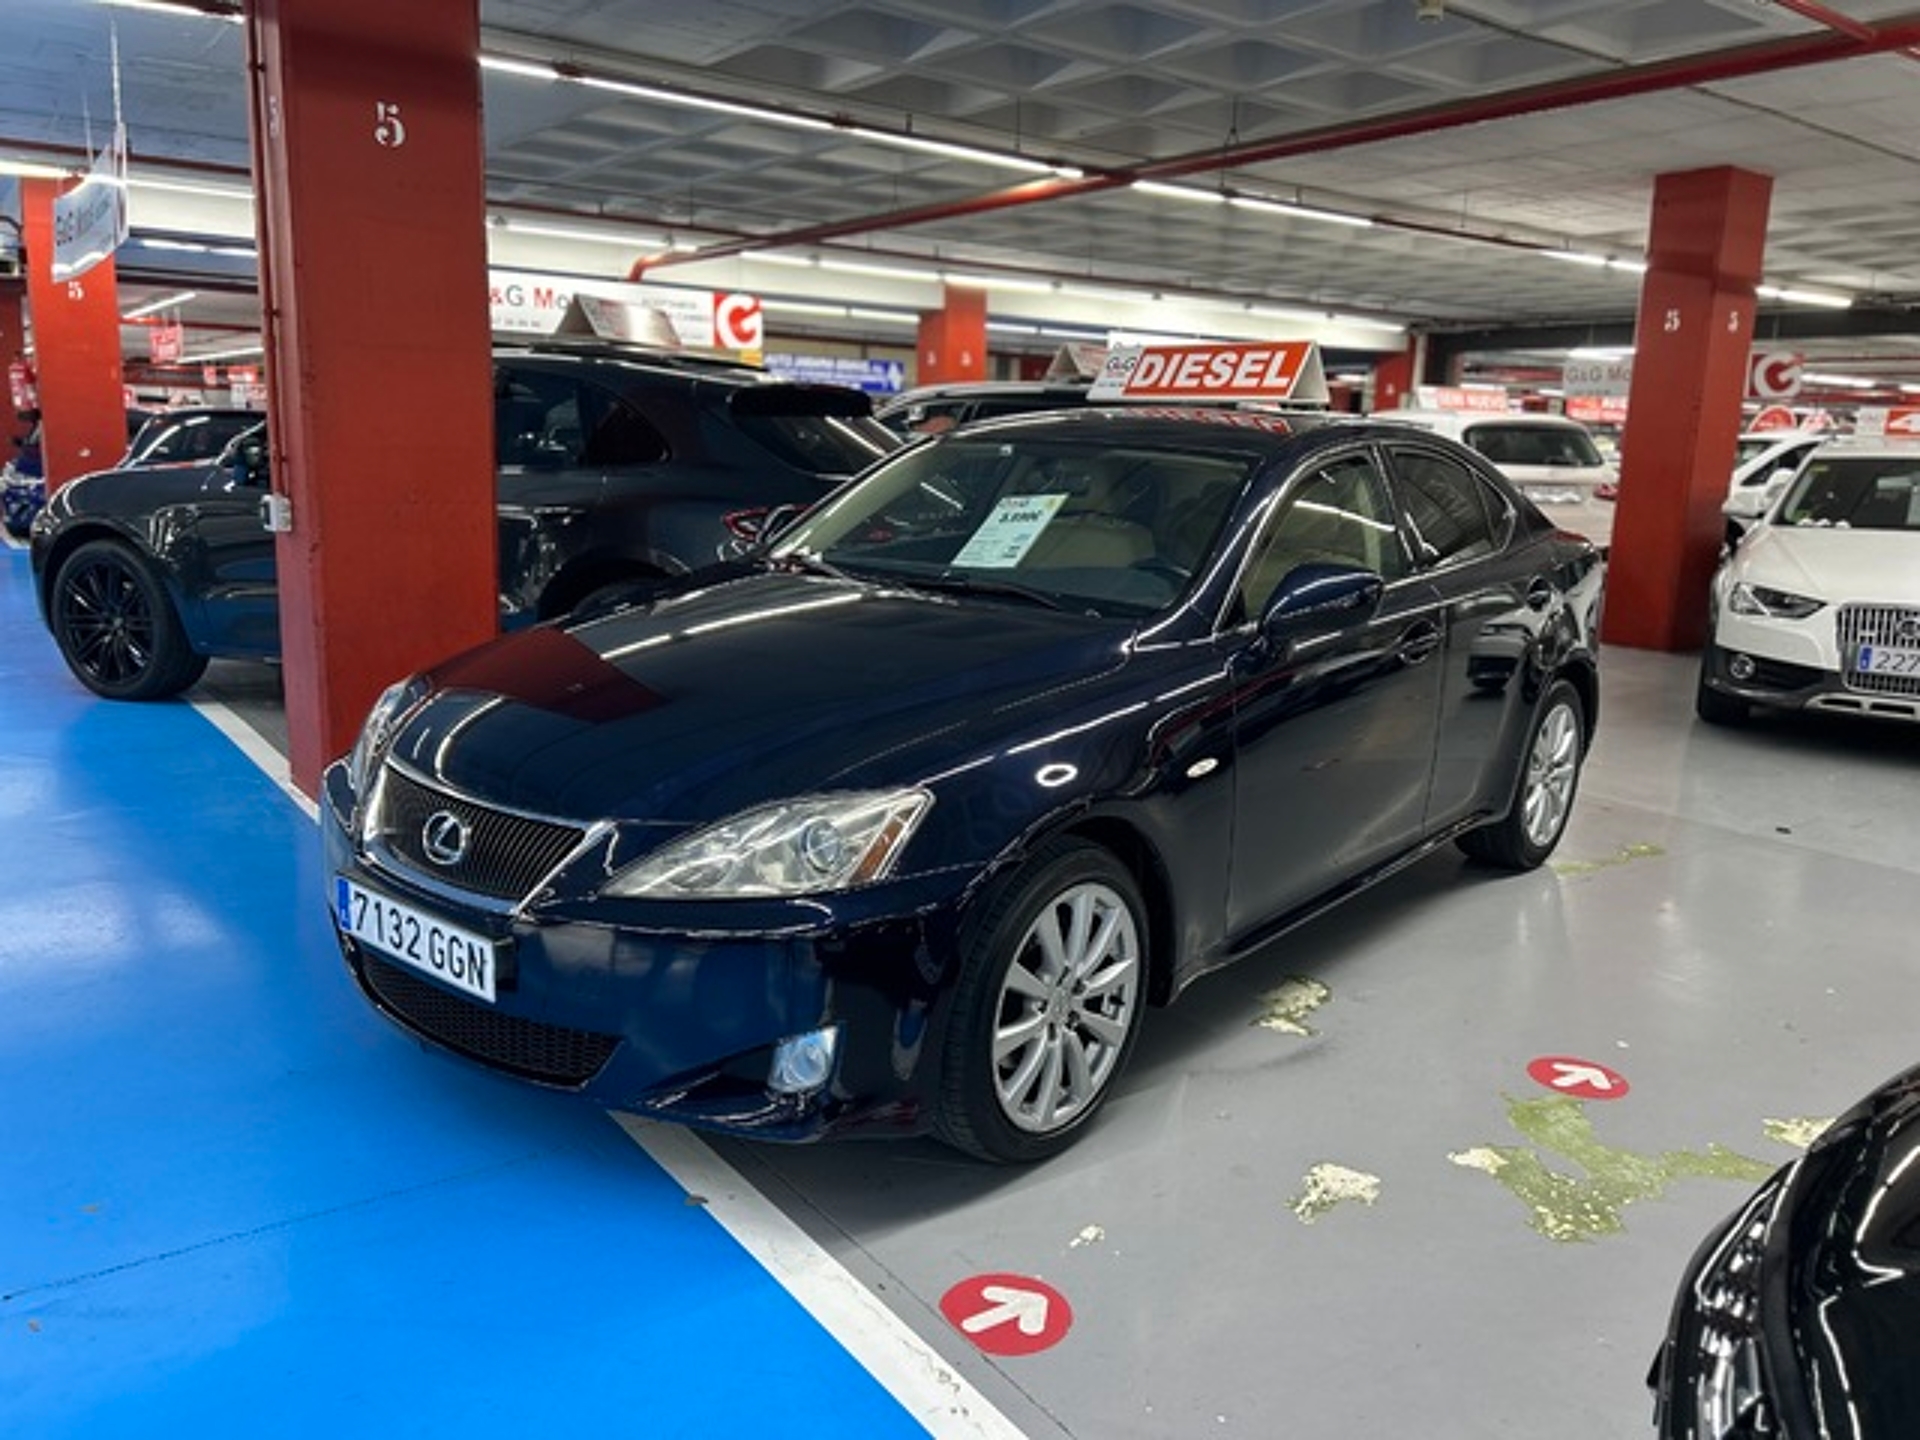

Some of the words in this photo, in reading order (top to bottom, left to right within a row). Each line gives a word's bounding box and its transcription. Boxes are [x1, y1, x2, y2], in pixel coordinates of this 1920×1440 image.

[374, 101, 405, 147] 5
[68, 281, 84, 300] 5
[1664, 309, 1681, 333] 5
[1130, 350, 1291, 388] DIESEL
[354, 890, 421, 961] 7132
[429, 926, 486, 991] GGN
